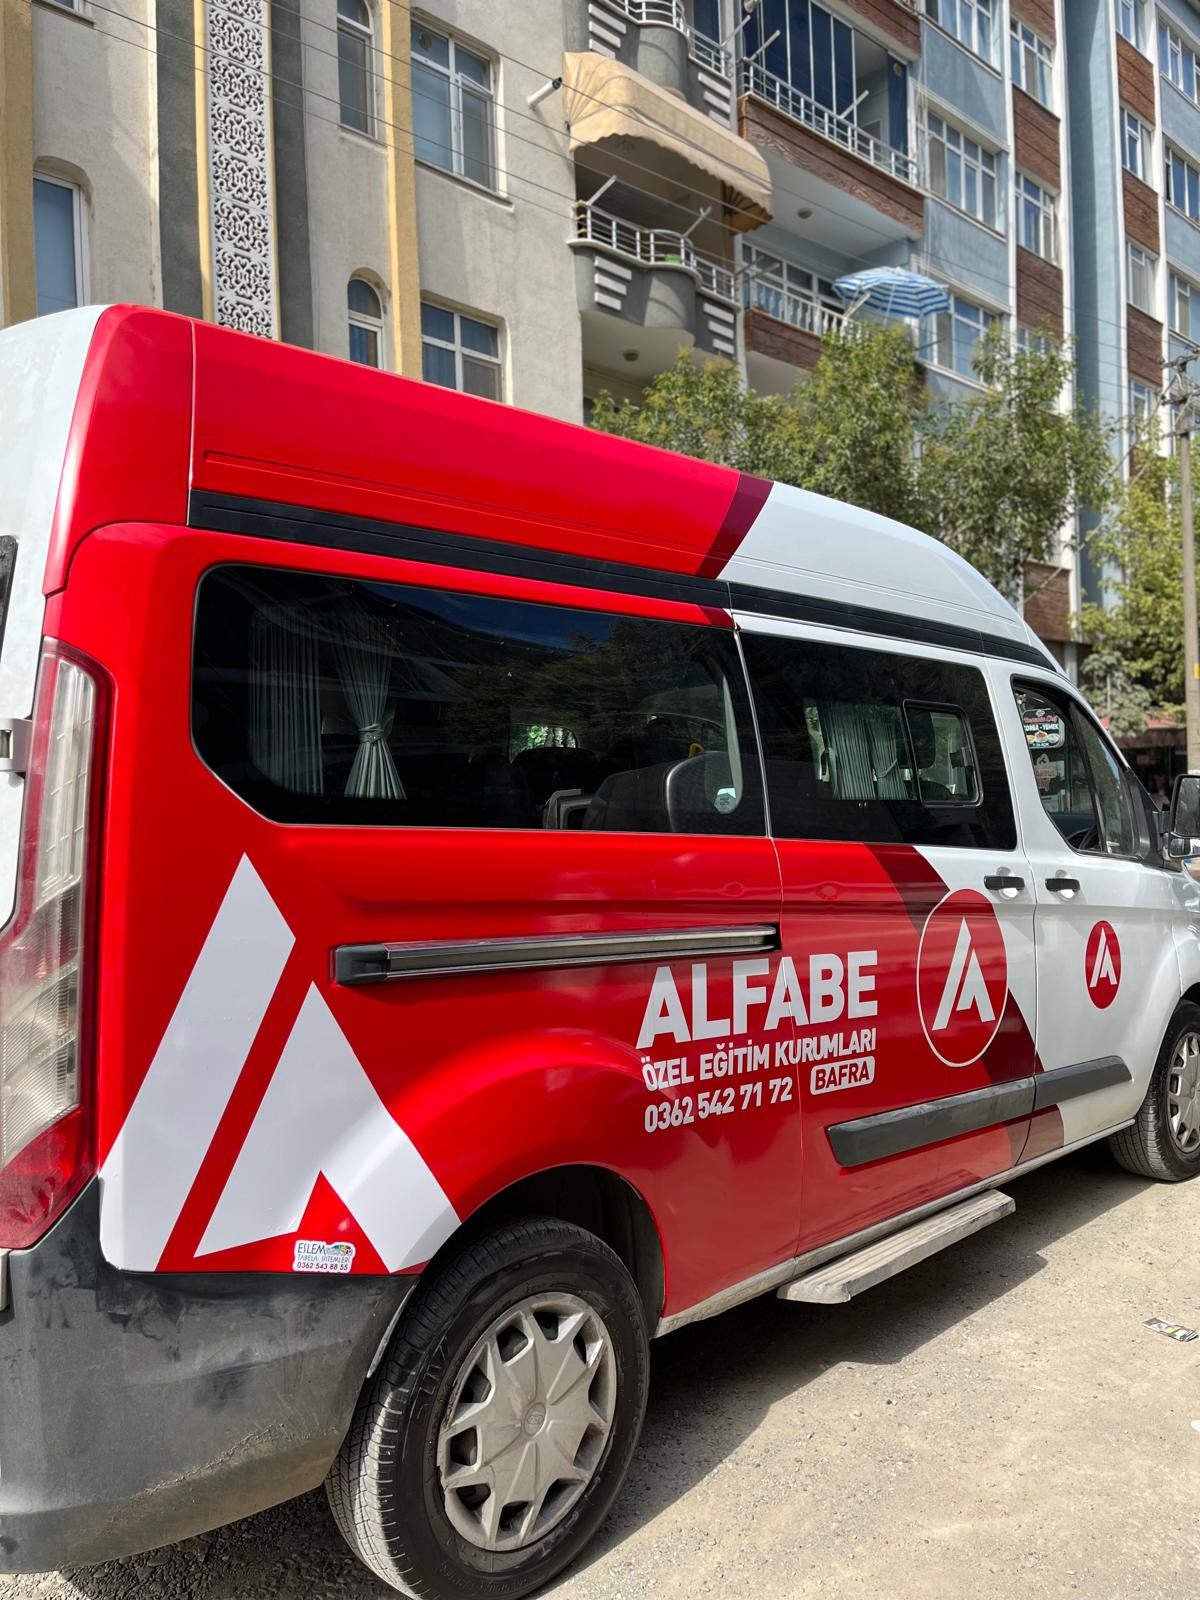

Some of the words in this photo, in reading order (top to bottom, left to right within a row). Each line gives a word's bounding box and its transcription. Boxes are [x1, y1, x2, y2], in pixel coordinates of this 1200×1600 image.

[635, 950, 878, 1050] ALFABE
[641, 1055, 694, 1092] ÖZEL
[700, 1039, 770, 1081] EĞİTİM
[775, 1027, 876, 1067] KURUMLARI
[815, 1060, 870, 1091] BAFRA
[644, 1096, 695, 1133] 0362
[697, 1088, 735, 1119] 542
[740, 1082, 763, 1110] 71
[769, 1076, 793, 1104] 72
[297, 1261, 313, 1269] 0362
[315, 1262, 328, 1270] 543
